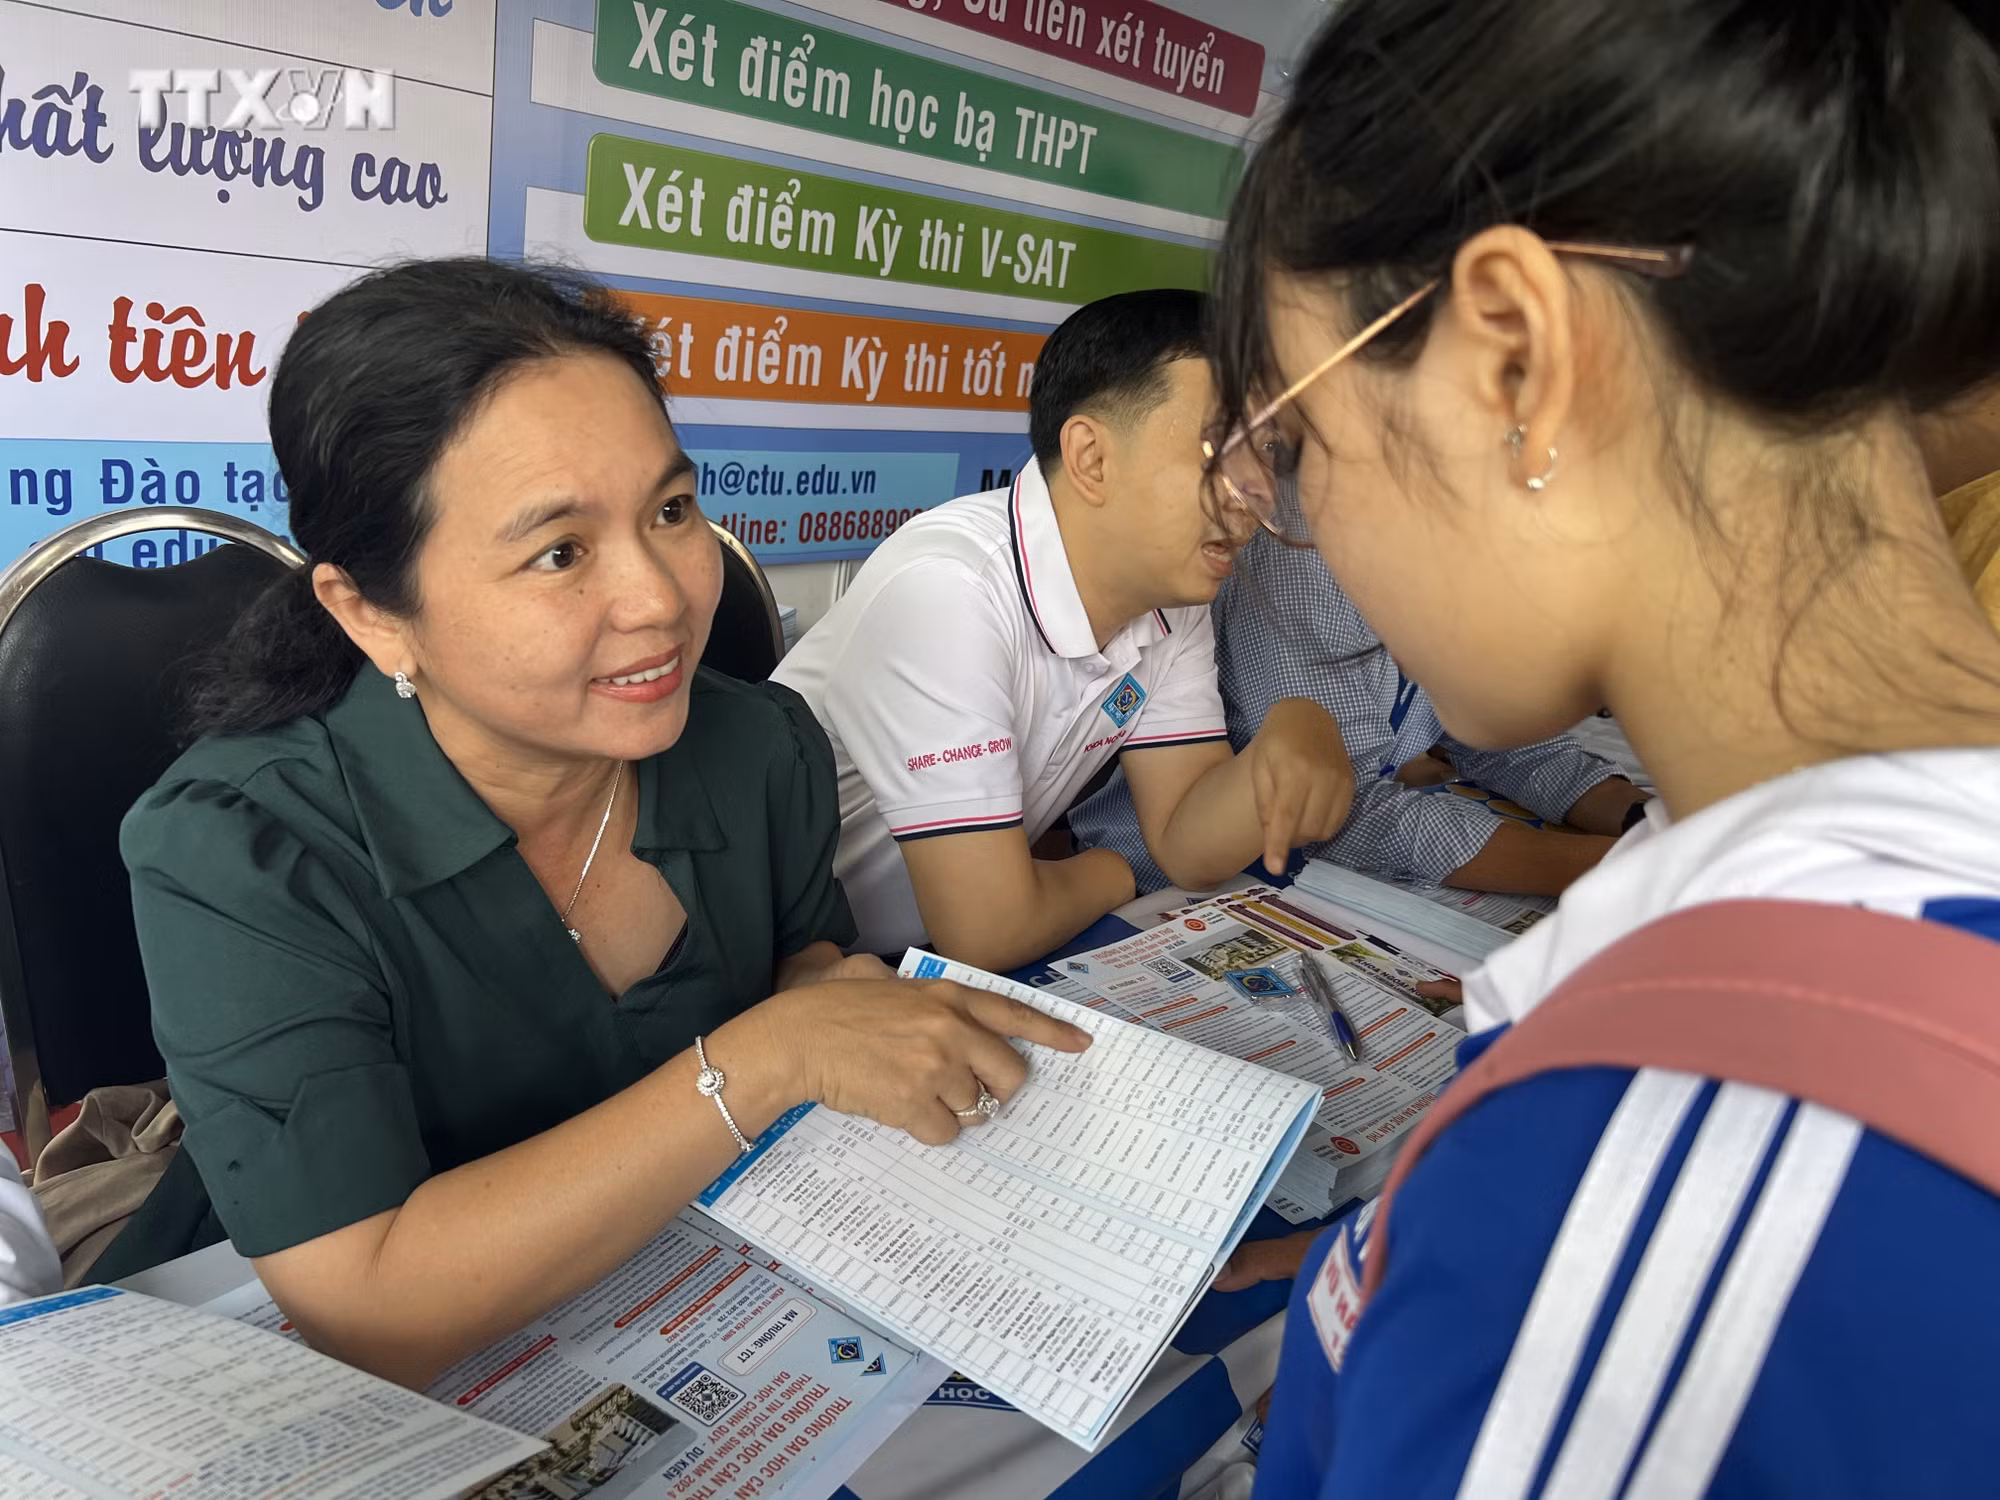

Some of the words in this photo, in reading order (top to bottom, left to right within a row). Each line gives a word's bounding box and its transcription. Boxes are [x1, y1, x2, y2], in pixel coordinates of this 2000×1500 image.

[1096, 12, 1145, 68] xét
[1153, 31, 1225, 94] tuyển
[629, 2, 717, 87] Xét
[739, 34, 849, 118] điểm
[870, 69, 938, 144] học
[954, 92, 996, 162] bạ
[1016, 107, 1097, 174] THPT
[138, 93, 324, 211] lượng
[351, 152, 448, 209] cao
[619, 161, 705, 237] Xét
[726, 180, 836, 256] điểm
[855, 206, 903, 277] Kỳ
[919, 218, 963, 273] thi
[980, 227, 1076, 289] V-SAT
[109, 296, 266, 390] tiên
[632, 317, 694, 378] ét
[715, 317, 821, 387] điểm
[841, 337, 889, 401] Kỳ
[905, 341, 949, 395] thi
[963, 341, 1006, 397] tốt
[100, 458, 200, 504] Đào
[781, 1309, 799, 1322] MÃ
[750, 1321, 787, 1349] TRƯỜNG:
[737, 1348, 755, 1363] TCT
[764, 1397, 784, 1413] TIN
[778, 1381, 833, 1426] TRƯỜNG
[939, 1387, 991, 1401] HỌC
[801, 1395, 855, 1439] TRƯỜNG
[705, 1424, 730, 1443] QUY
[757, 1419, 786, 1442] ĐẠI
[683, 1445, 705, 1462] DỰ
[712, 1435, 741, 1458] SINH
[732, 1438, 765, 1464] HỌC
[661, 1458, 692, 1482] KIẾN
[708, 1462, 744, 1489] CẦN
[684, 1482, 717, 1500] TH
